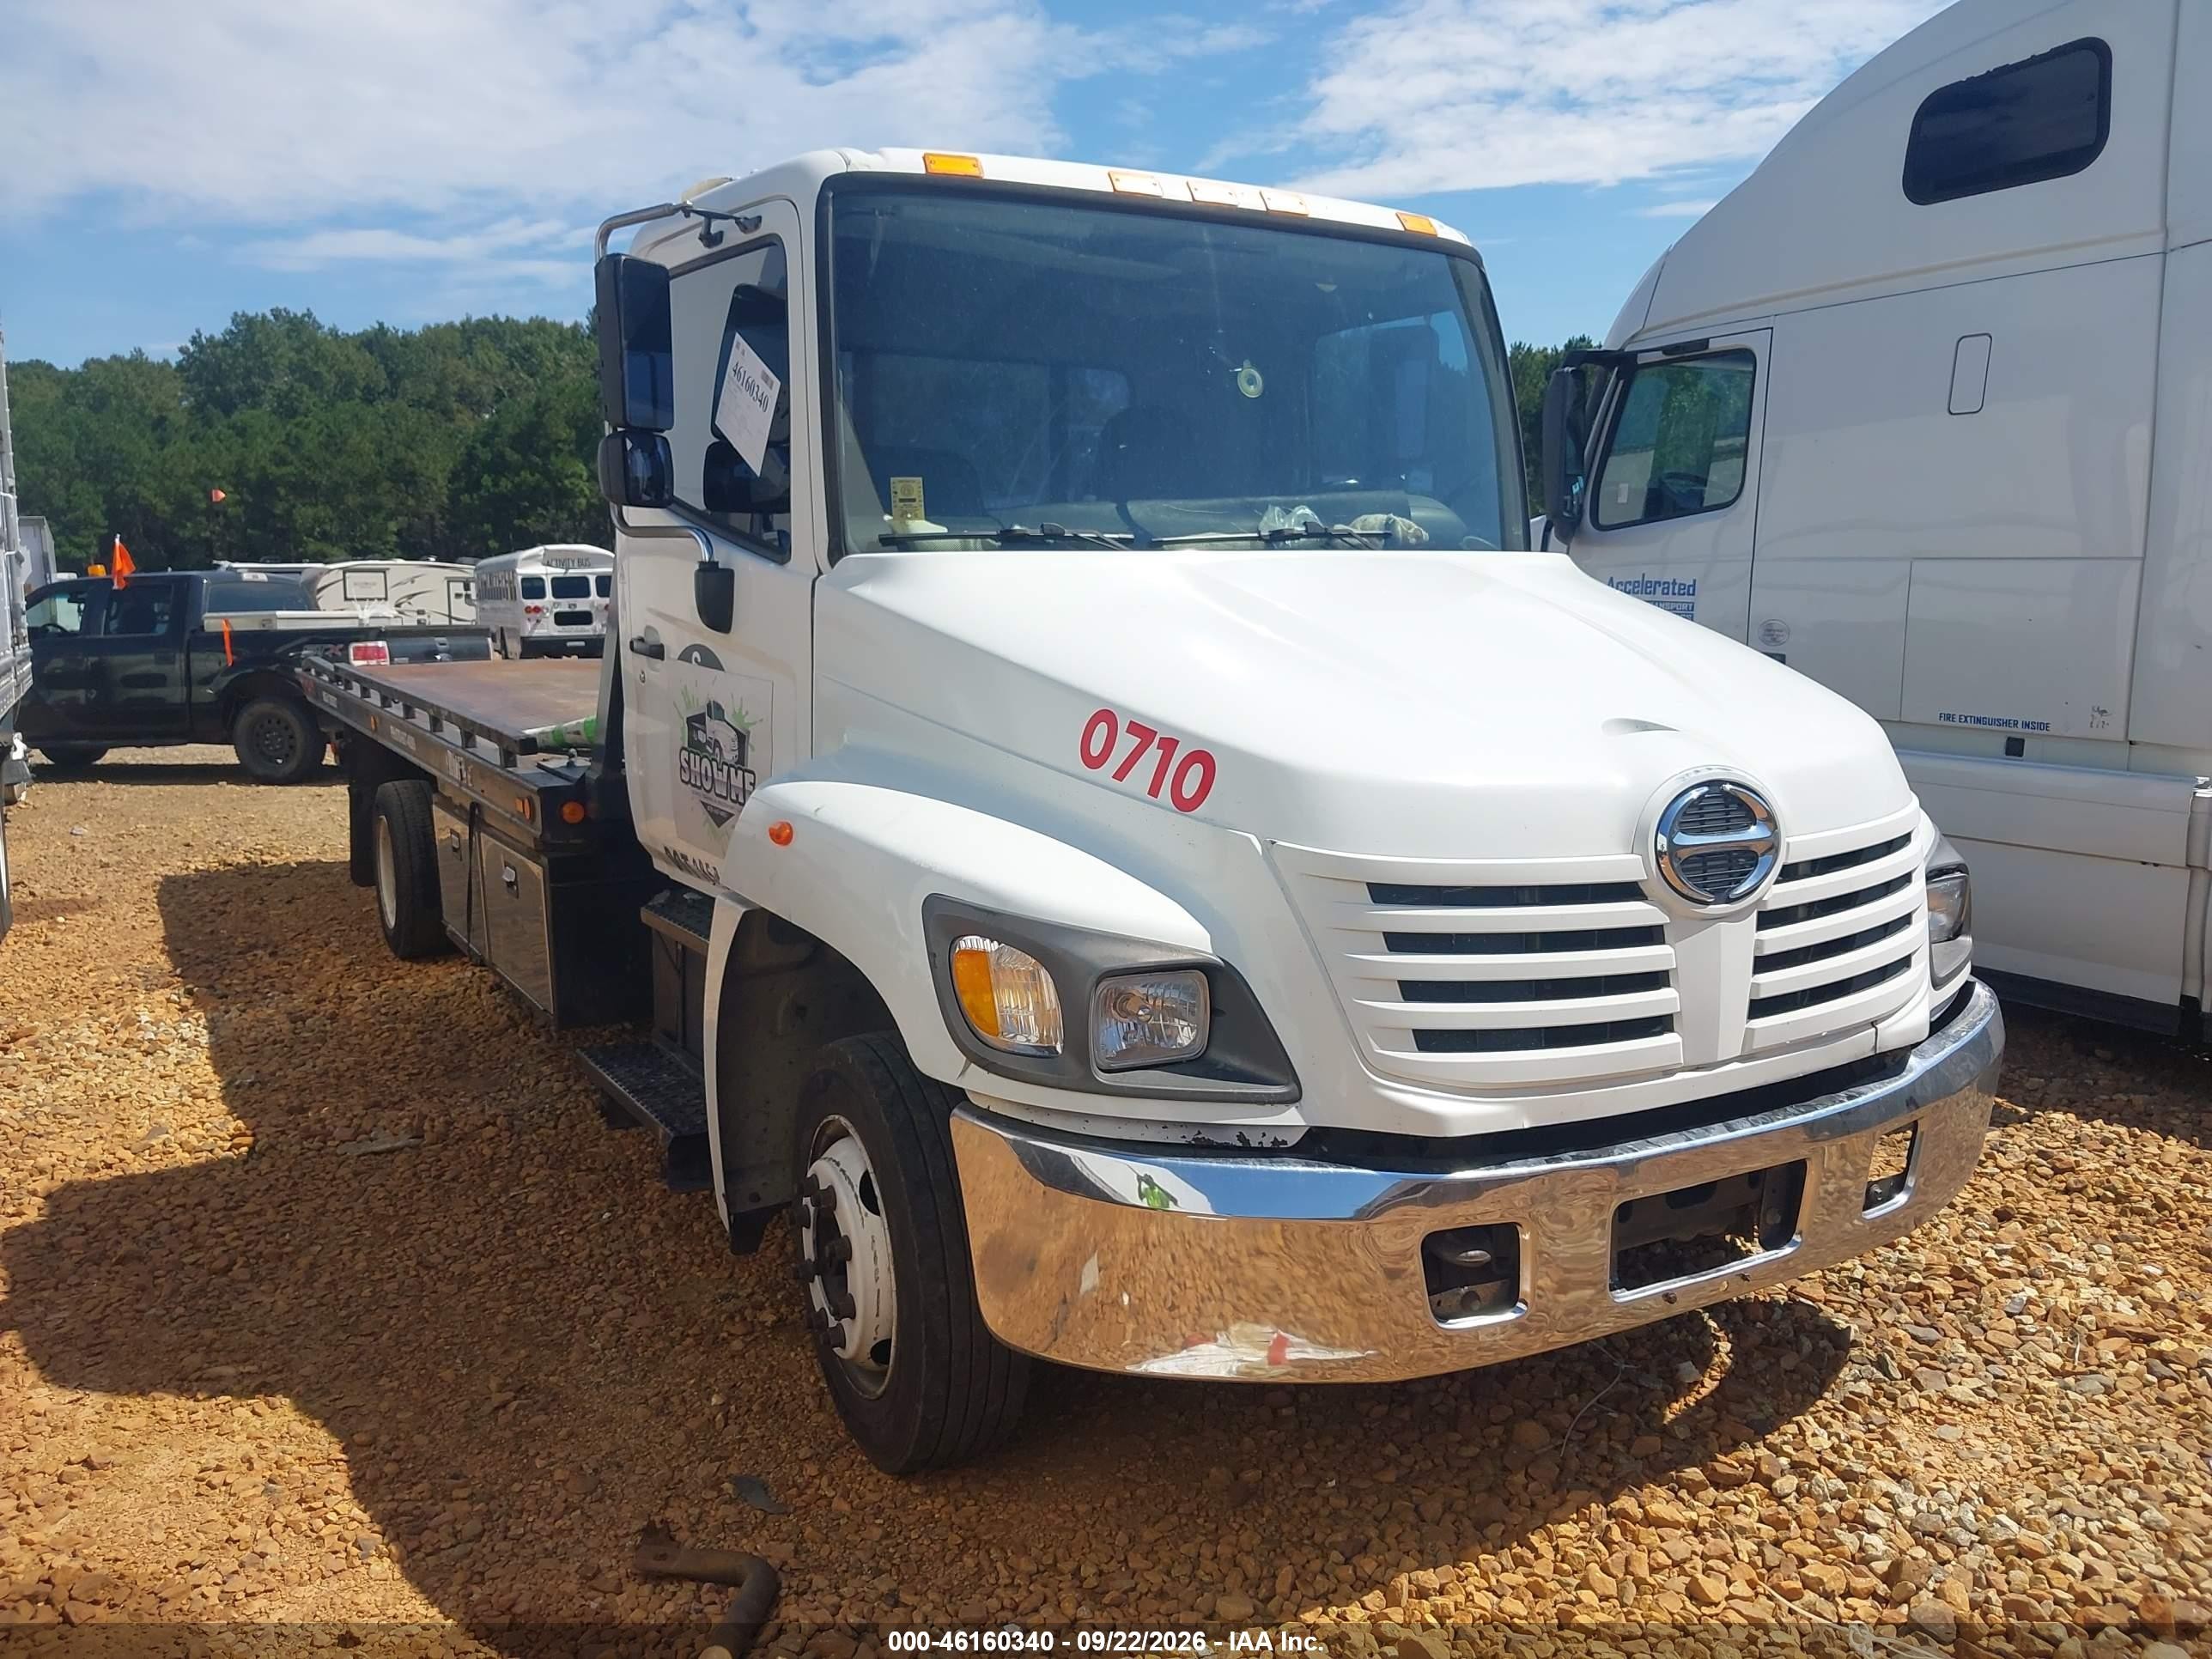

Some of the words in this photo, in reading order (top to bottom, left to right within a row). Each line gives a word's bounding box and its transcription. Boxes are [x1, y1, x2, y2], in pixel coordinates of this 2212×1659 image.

[732, 361, 769, 413] 46160340
[578, 557, 591, 568] BUS
[1607, 573, 1697, 596] Accelerated
[1651, 602, 1693, 611] ANSPORT
[1938, 712, 1956, 723] FIRE
[1959, 714, 2019, 729] EXTINGUISHER
[2021, 720, 2051, 732] INSIDE
[1080, 708, 1217, 813] 0710
